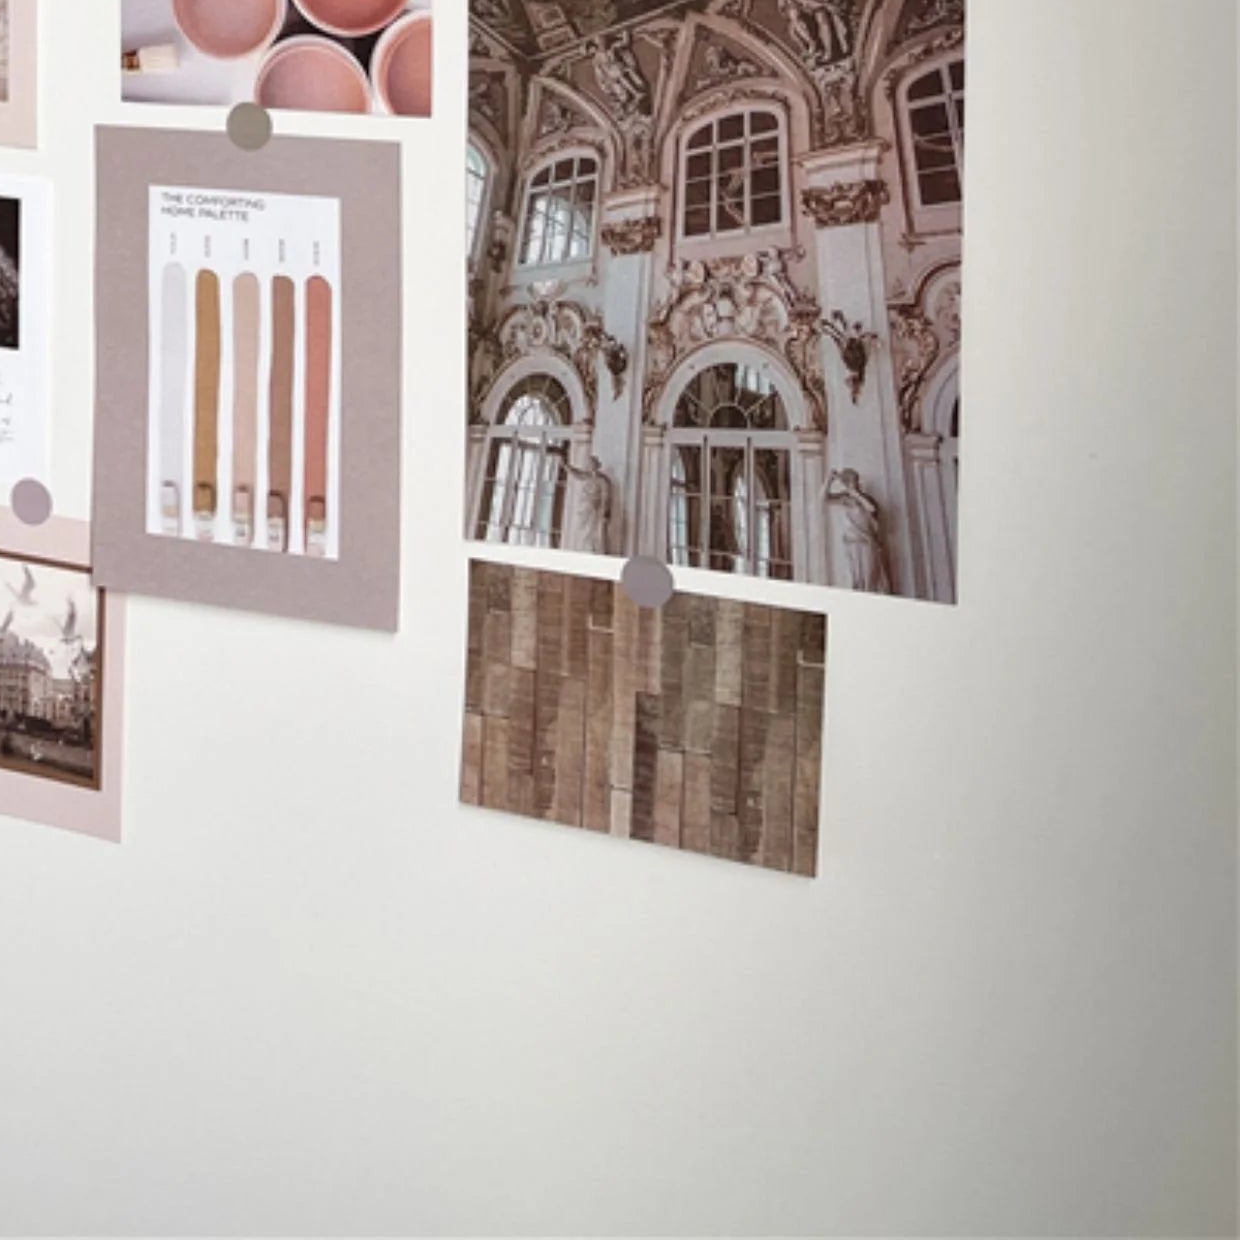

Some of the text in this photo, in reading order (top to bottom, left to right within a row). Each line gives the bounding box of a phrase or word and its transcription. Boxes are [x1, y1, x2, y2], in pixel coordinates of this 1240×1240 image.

[160, 191, 268, 212] THE COMFORTING
[160, 206, 251, 223] HOME PALETTE
